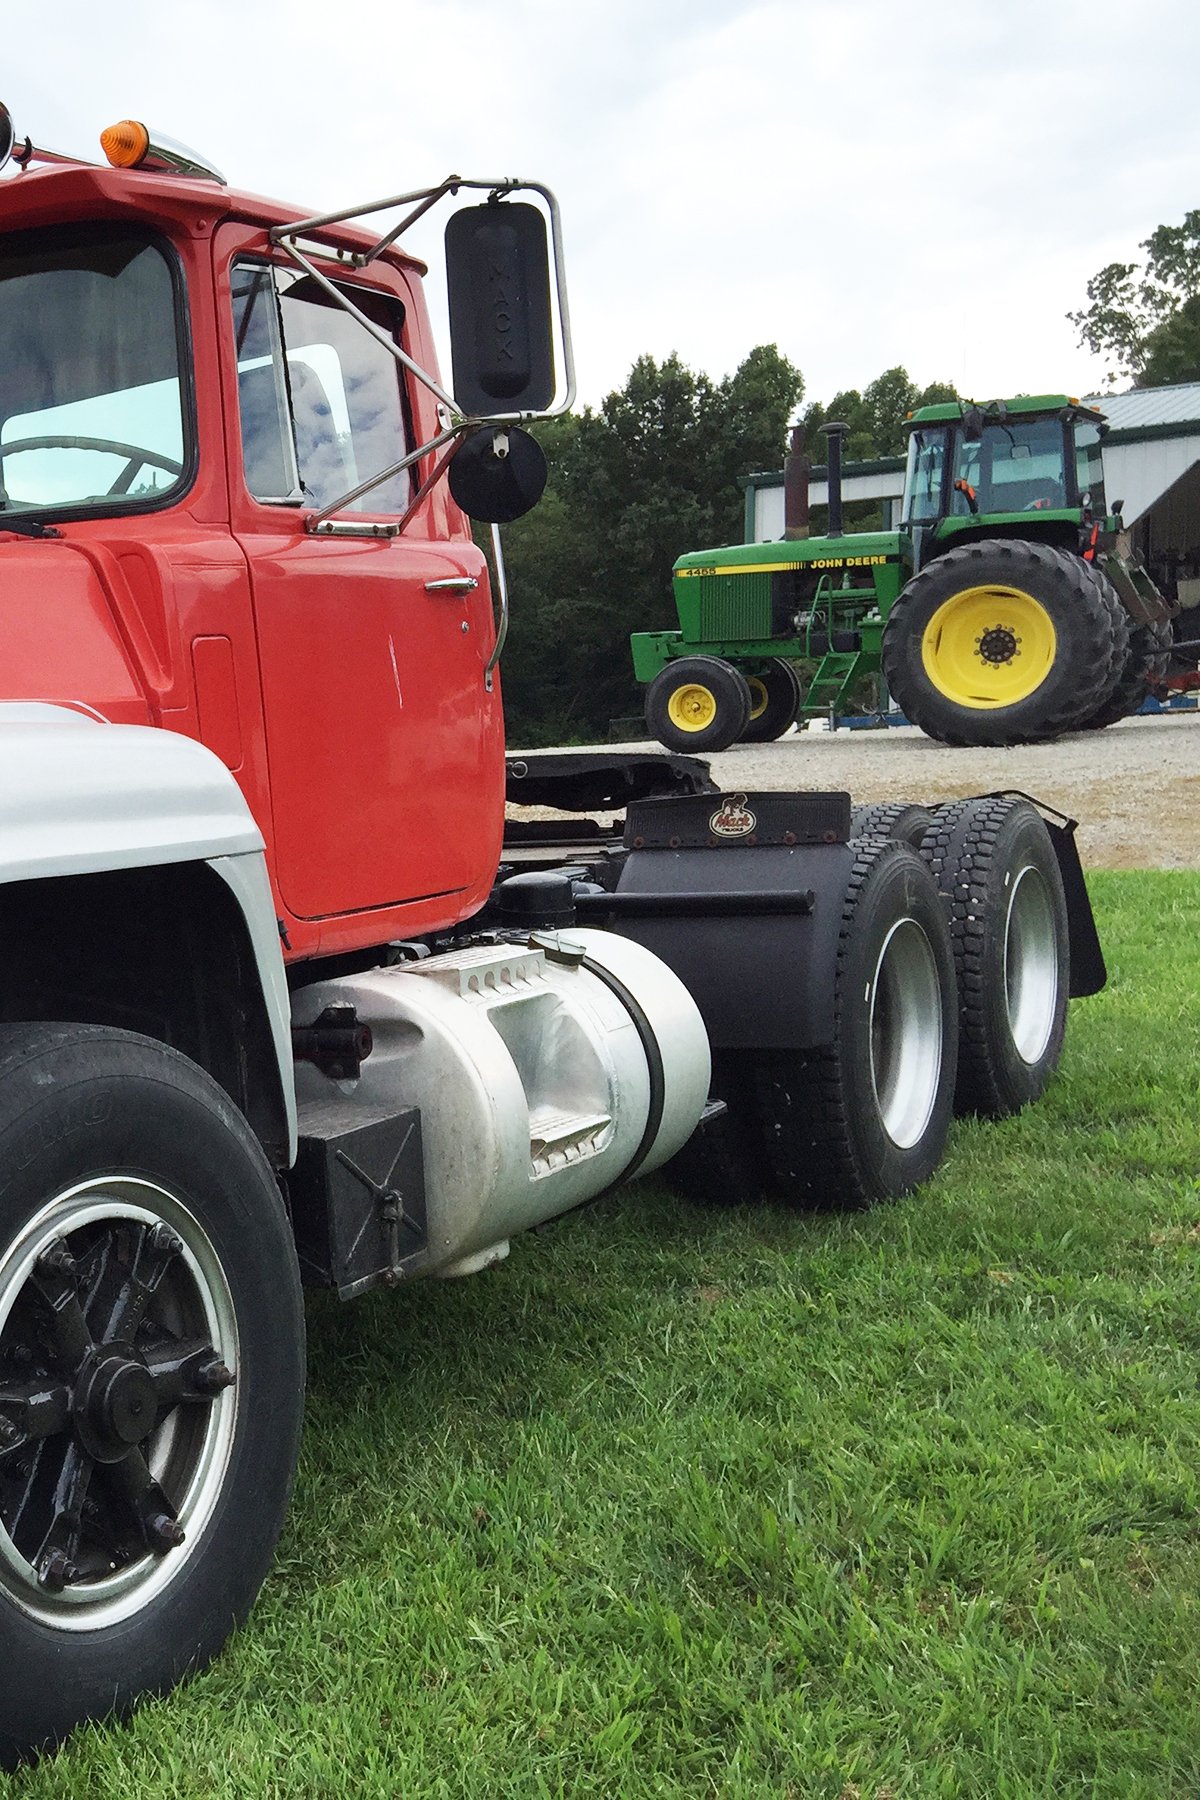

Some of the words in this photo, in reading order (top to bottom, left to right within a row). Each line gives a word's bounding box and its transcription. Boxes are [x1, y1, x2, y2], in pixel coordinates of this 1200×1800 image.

[487, 264, 514, 362] MACK
[810, 558, 843, 569] JOHN
[846, 555, 887, 567] DEERE
[715, 813, 751, 828] Mack
